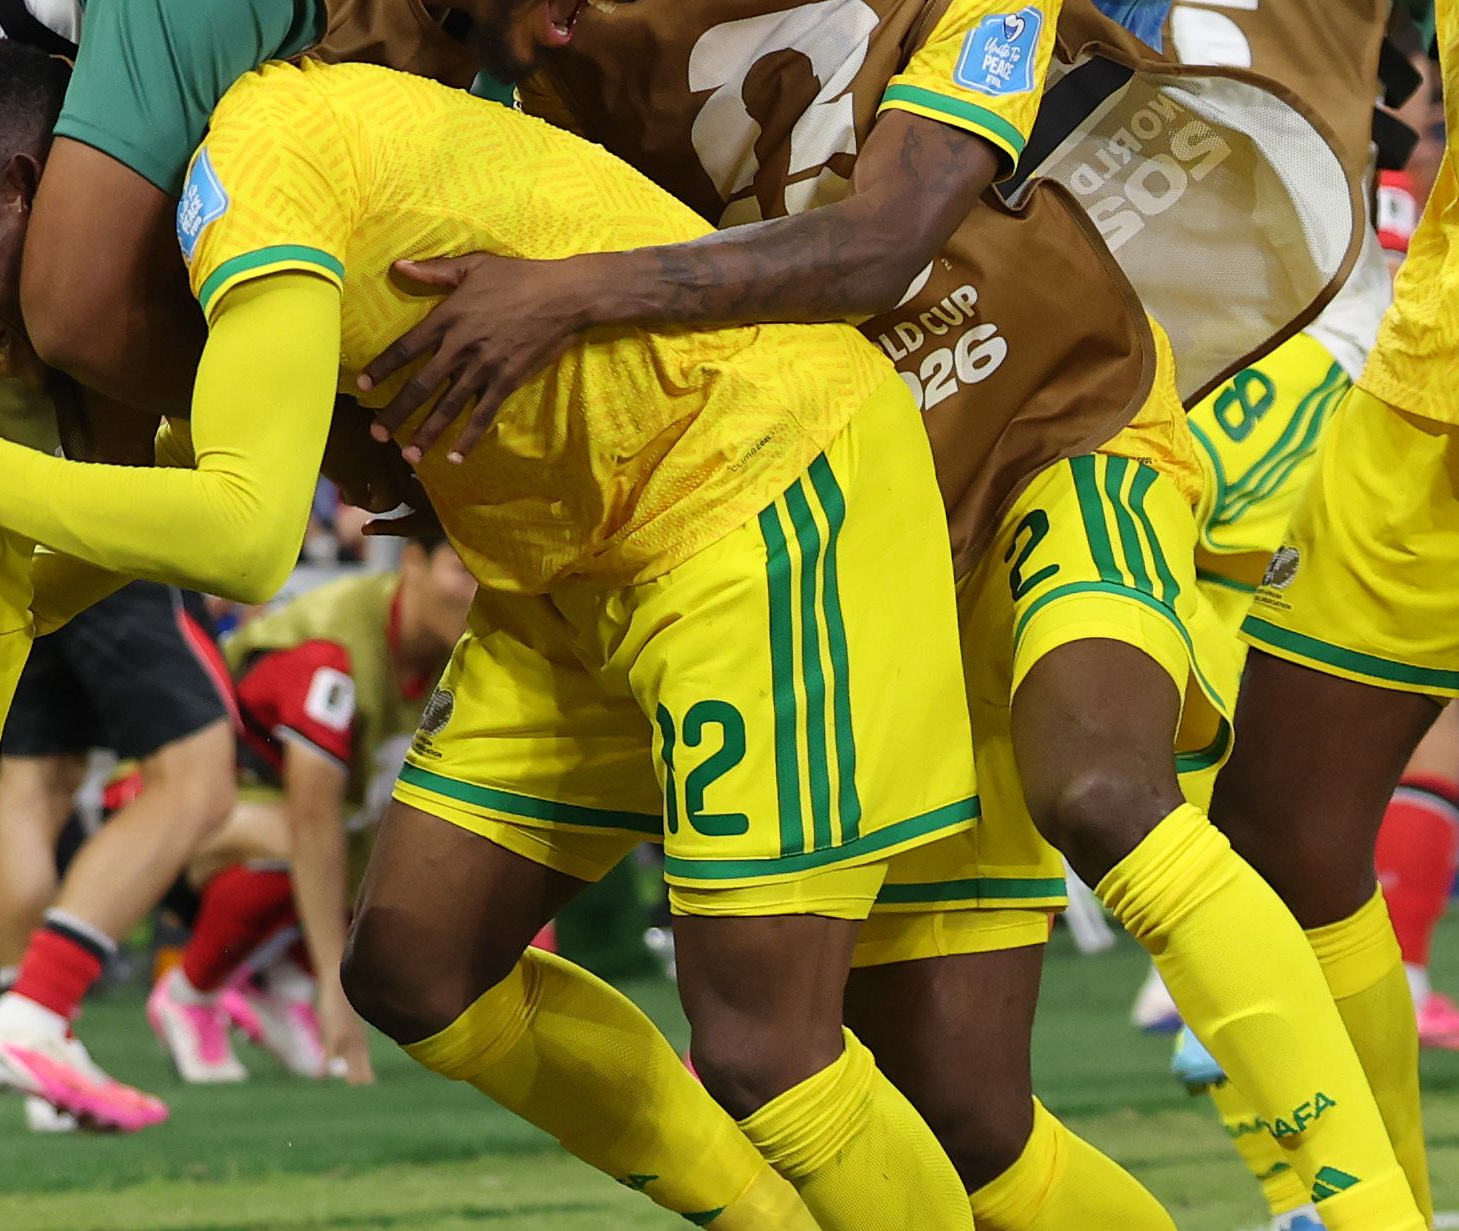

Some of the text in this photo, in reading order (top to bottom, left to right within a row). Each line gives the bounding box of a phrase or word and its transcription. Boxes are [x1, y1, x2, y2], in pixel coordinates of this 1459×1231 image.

[981, 53, 1015, 81] PEACE
[919, 284, 978, 336] CUP
[1213, 368, 1275, 442] 8
[656, 700, 750, 836] 12
